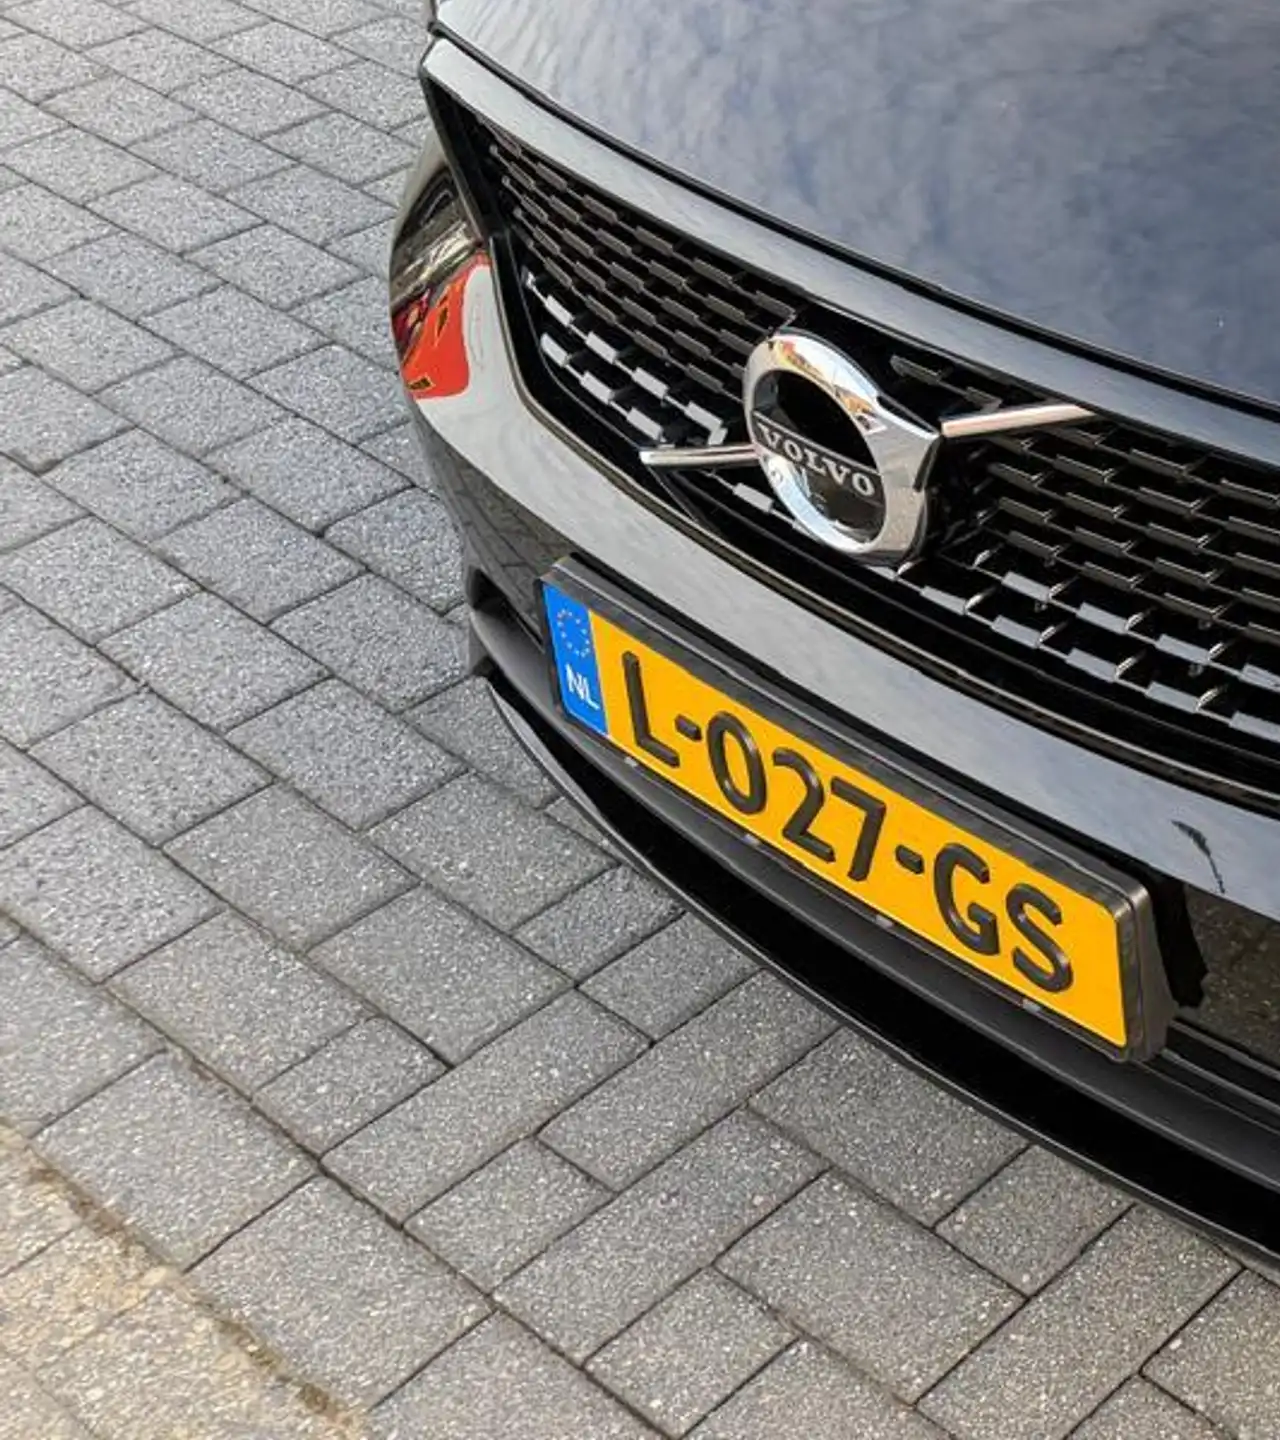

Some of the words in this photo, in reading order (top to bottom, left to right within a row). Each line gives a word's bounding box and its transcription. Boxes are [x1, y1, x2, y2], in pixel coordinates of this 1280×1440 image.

[756, 421, 876, 497] VOLVO
[564, 662, 601, 711] NL
[620, 650, 1074, 993] L-027-GS
